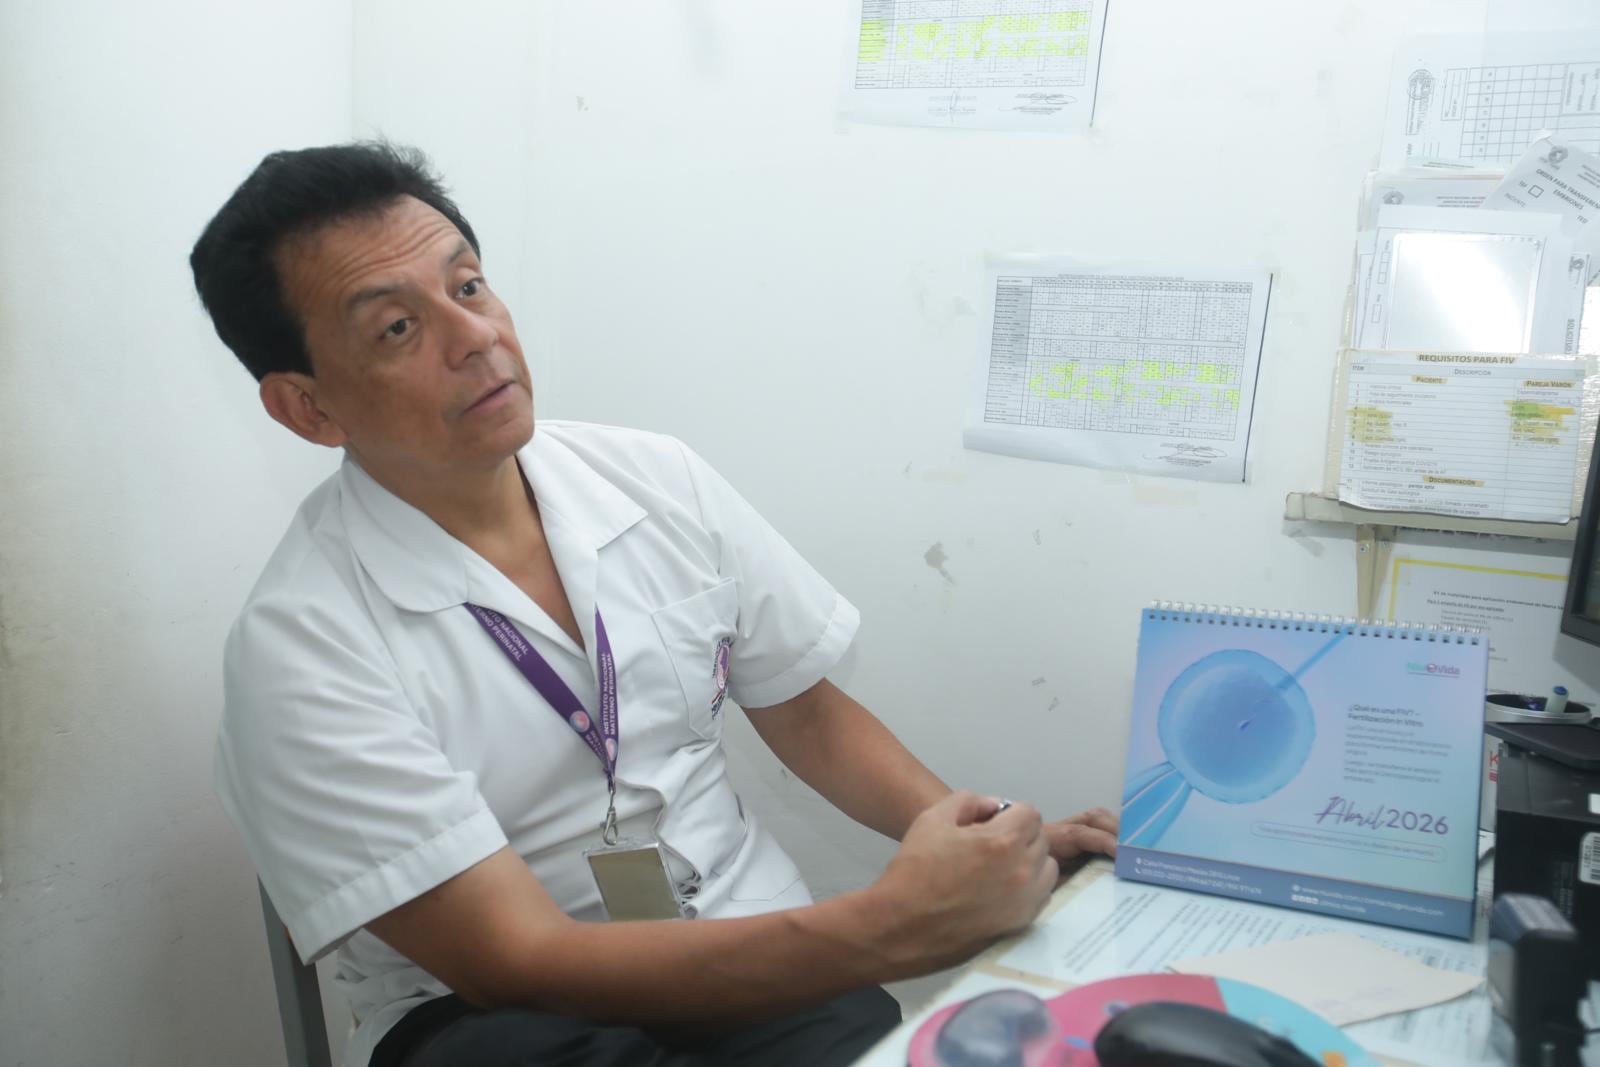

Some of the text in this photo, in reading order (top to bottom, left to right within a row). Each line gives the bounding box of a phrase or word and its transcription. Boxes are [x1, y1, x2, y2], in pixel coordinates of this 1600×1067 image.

[1419, 354, 1516, 364] REQUISITOS PARA FIV
[492, 625, 522, 662] PERINATAL
[500, 622, 528, 655] NACIONAL
[606, 652, 616, 735] MATERNO PERINATAL
[1314, 796, 1450, 835] Abril 2026
